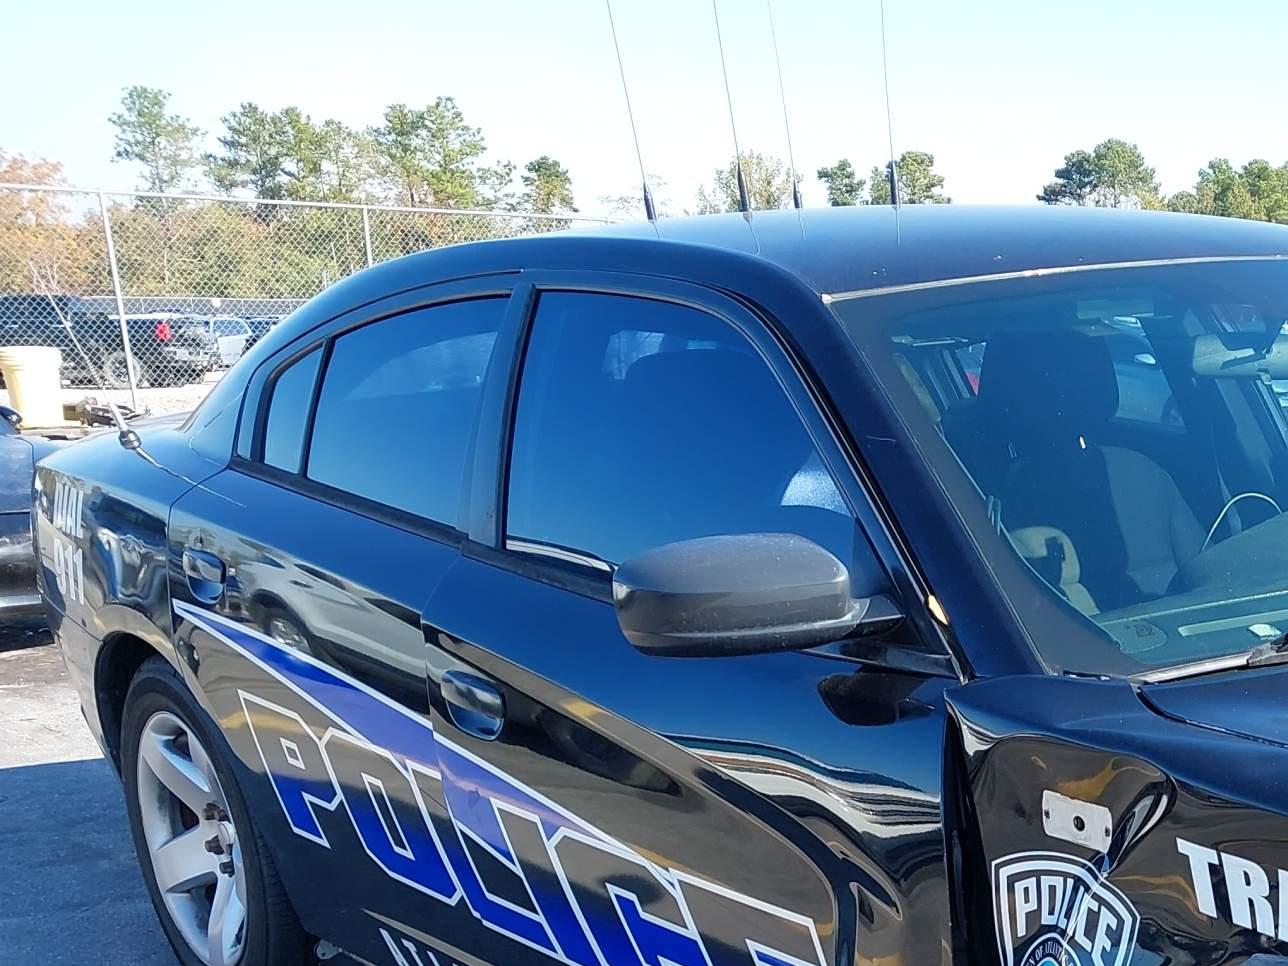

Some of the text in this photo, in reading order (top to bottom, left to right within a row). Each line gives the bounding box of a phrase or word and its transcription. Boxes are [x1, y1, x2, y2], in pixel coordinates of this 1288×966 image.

[53, 480, 84, 539] DIAL
[54, 538, 84, 606] 911
[1035, 945, 1044, 961] OF
